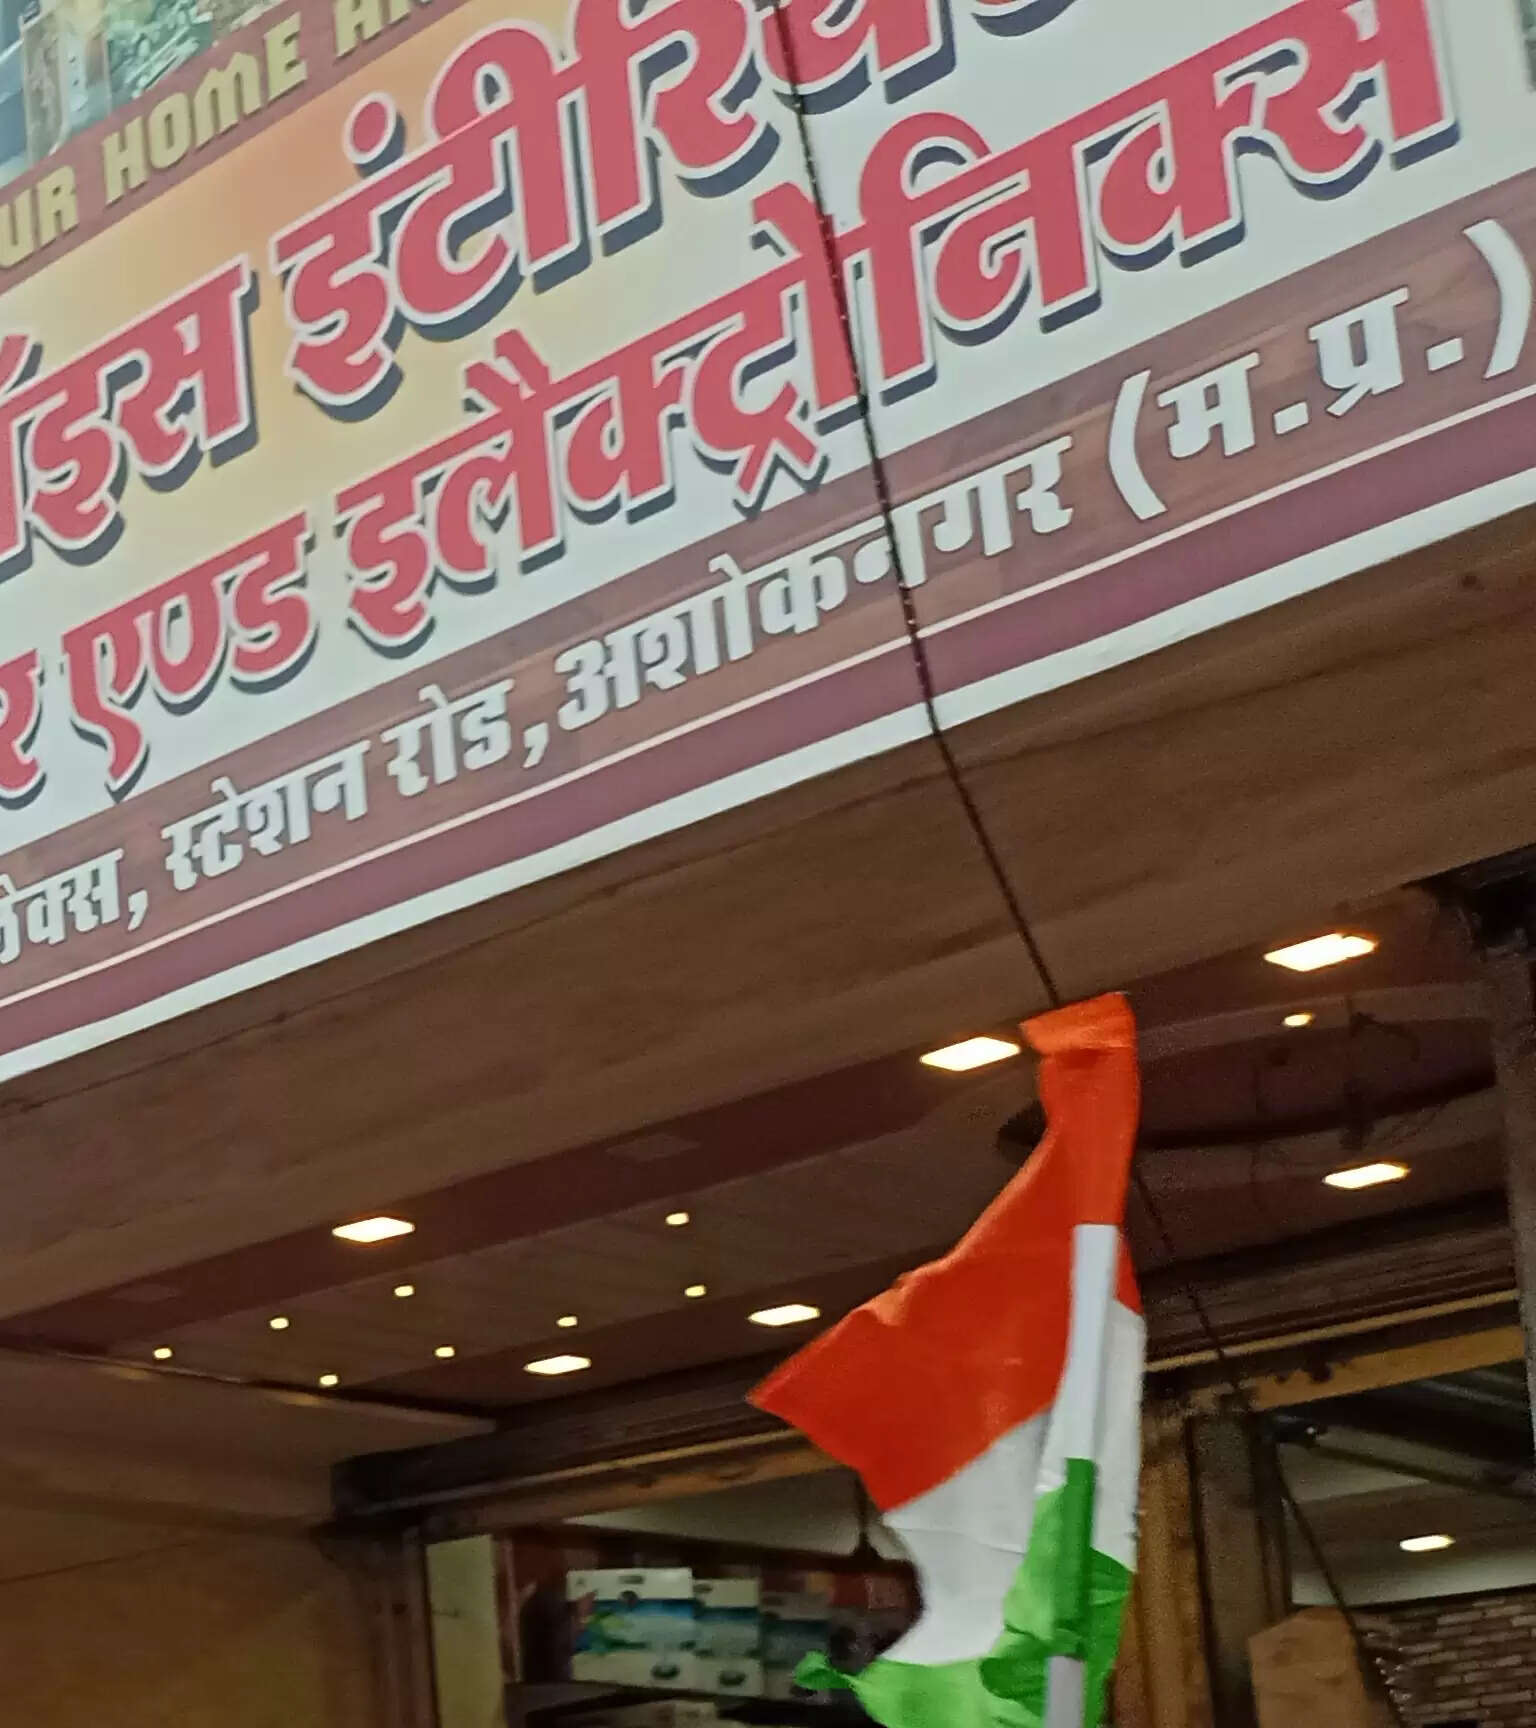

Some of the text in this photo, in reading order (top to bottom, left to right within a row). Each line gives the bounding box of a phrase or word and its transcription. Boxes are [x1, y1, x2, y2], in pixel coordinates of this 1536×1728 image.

[102, 13, 308, 206] HOME
[62, 514, 316, 793] एण्ड
[161, 739, 371, 891] स्टेशन
